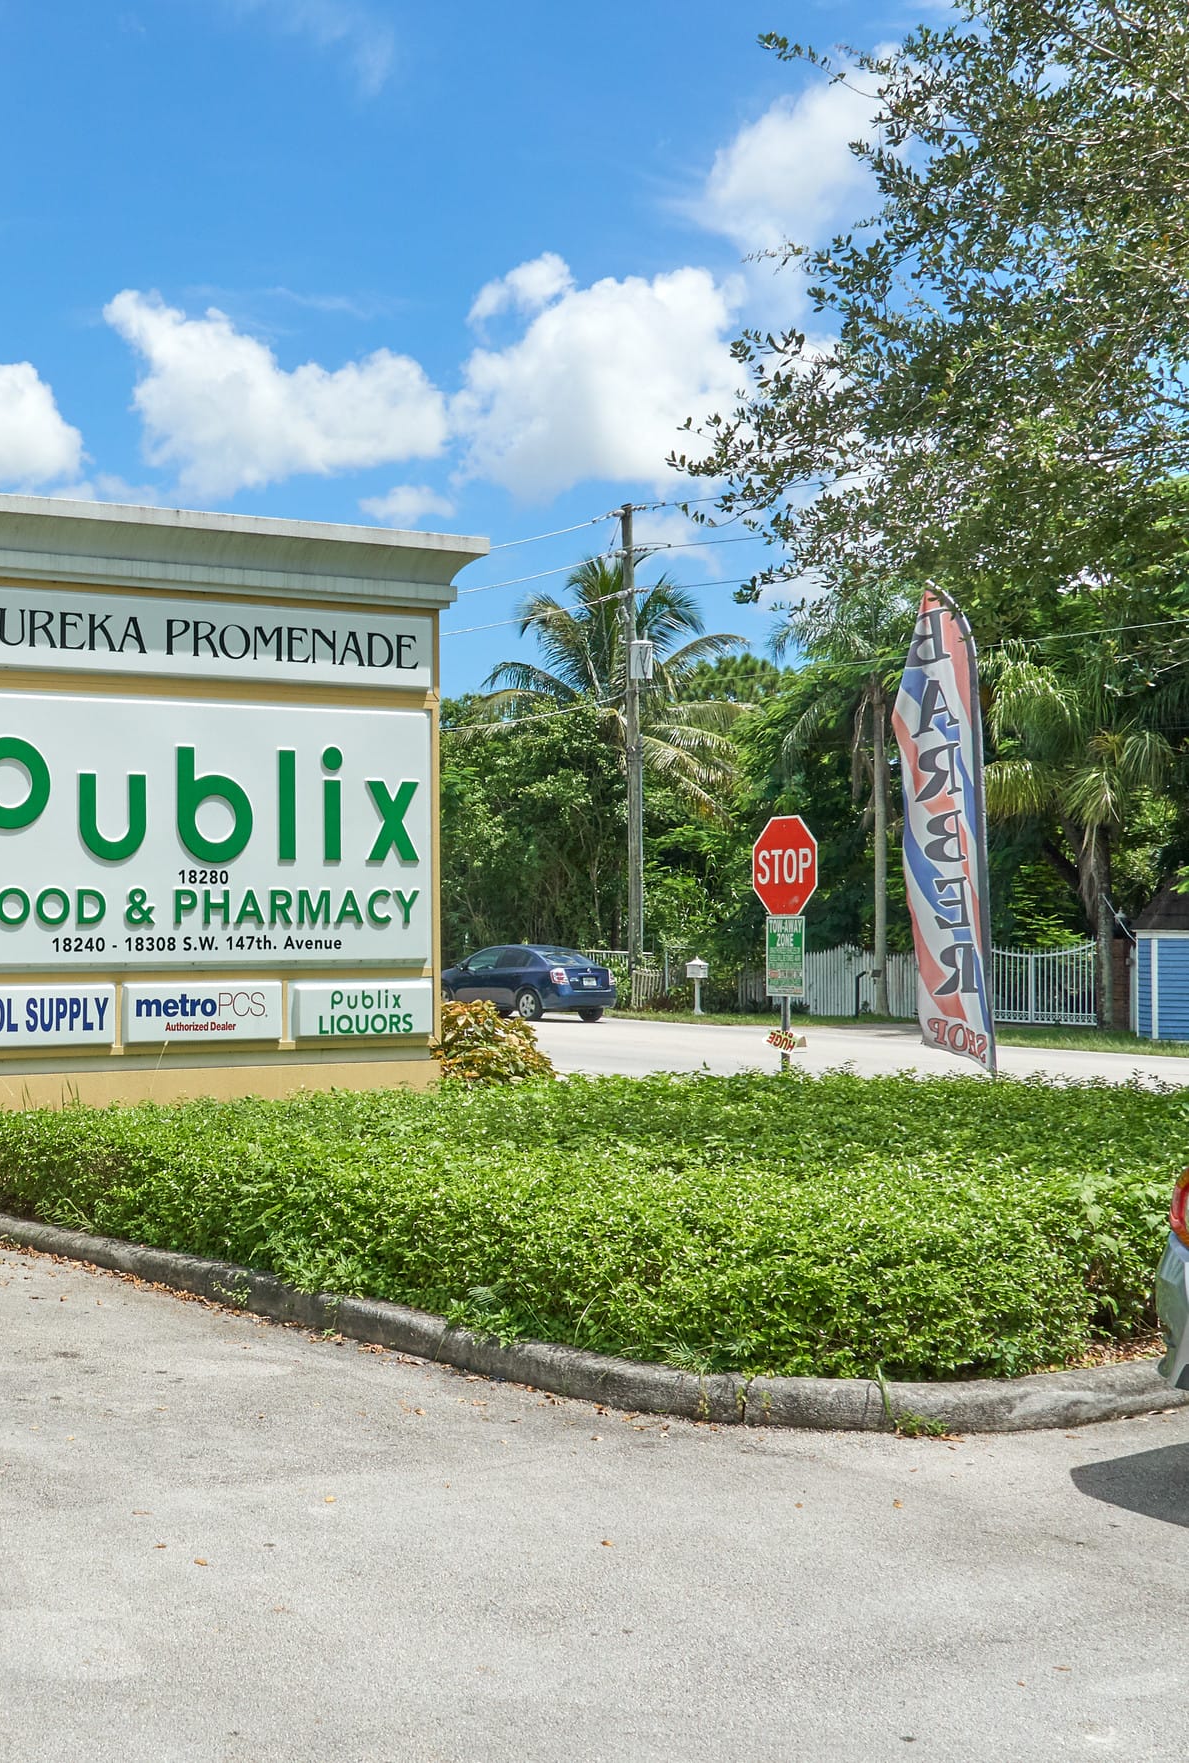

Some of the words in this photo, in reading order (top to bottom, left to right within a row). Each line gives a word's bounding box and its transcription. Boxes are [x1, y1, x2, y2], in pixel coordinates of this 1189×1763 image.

[165, 618, 420, 670] PROMENADE
[757, 847, 813, 884] STOP
[178, 870, 229, 884] 18280
[125, 888, 155, 925] &
[173, 888, 419, 925] PHARMACY
[769, 919, 802, 933] TOW-AWAY
[52, 937, 106, 952] 18240
[125, 936, 176, 951] 18308
[183, 936, 219, 950] S.W.
[226, 935, 277, 950] 147th.
[284, 936, 342, 950] Avenue
[776, 933, 794, 947] ZONE
[135, 992, 267, 1018] metroPCS
[331, 989, 401, 1010] Publix
[25, 997, 109, 1032] SUPPLY
[319, 1013, 413, 1035] LIQUORS
[165, 1022, 209, 1032] Authorized
[210, 1021, 237, 1031] Dealer
[766, 1031, 795, 1052] HUGE
